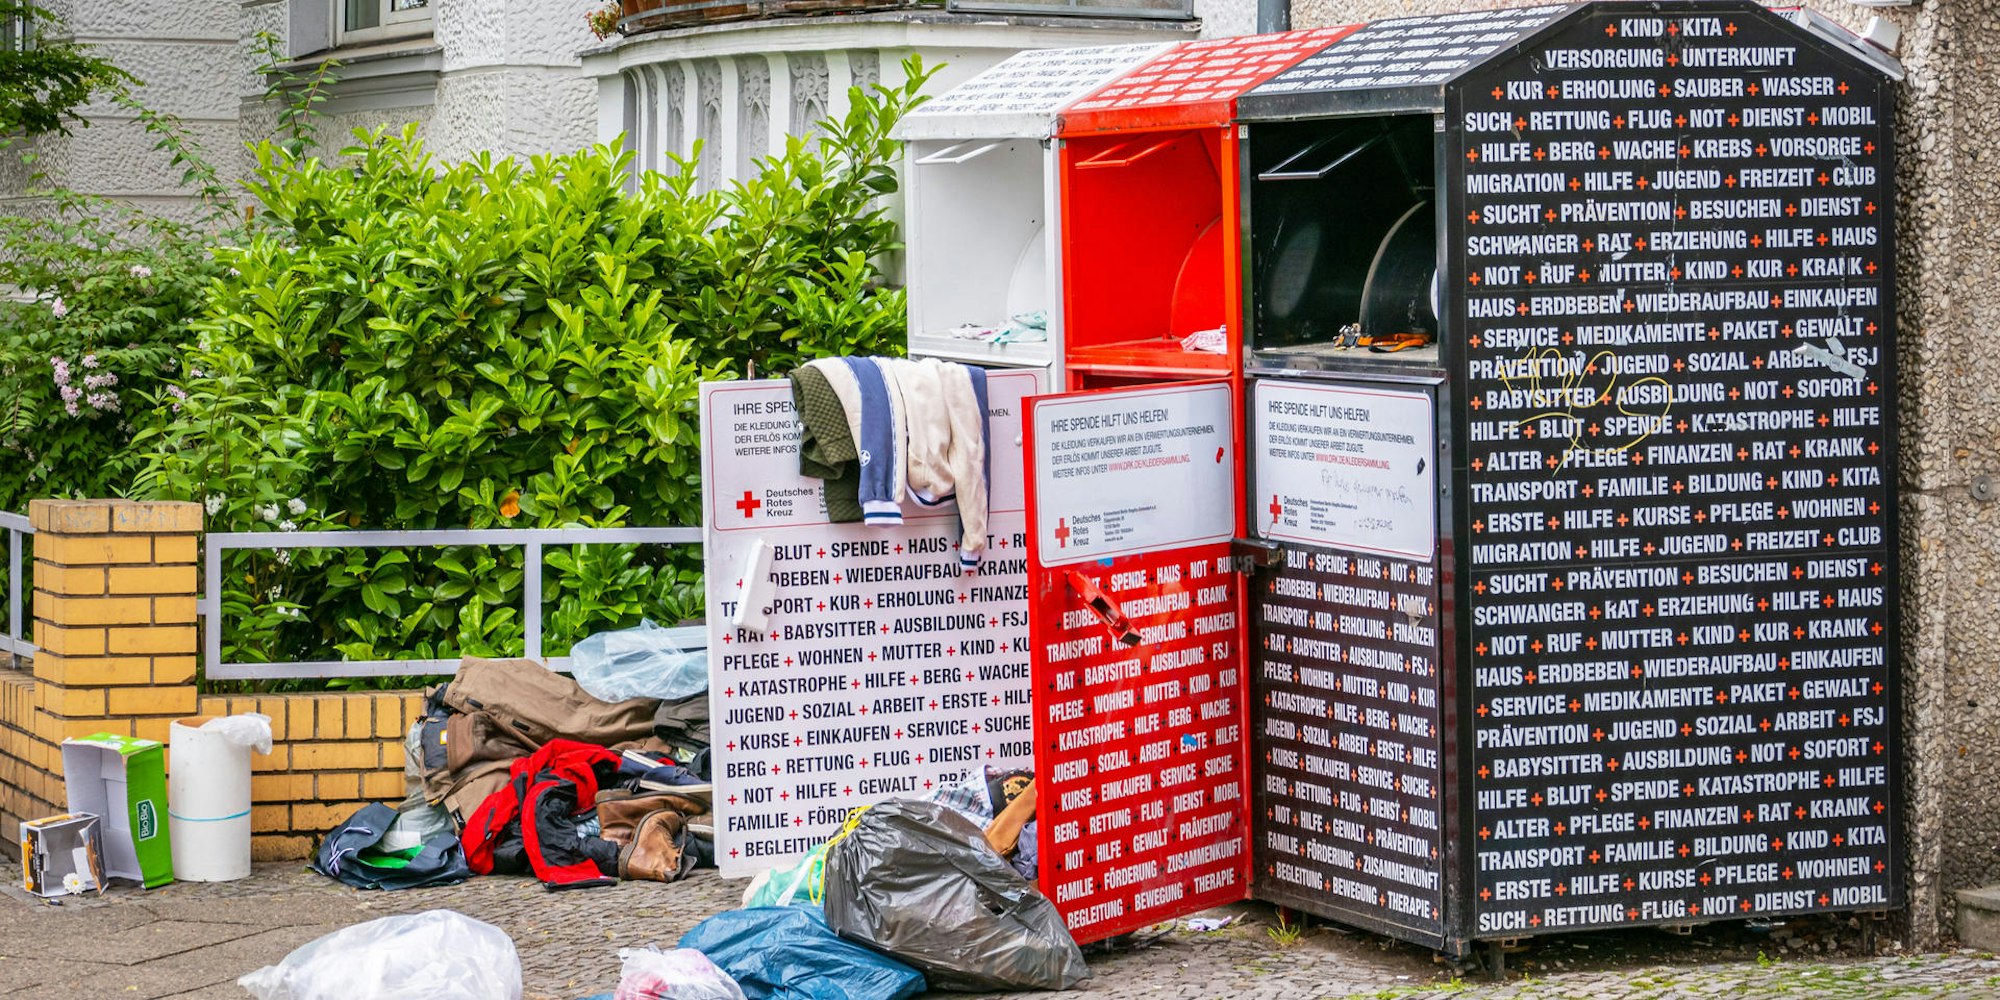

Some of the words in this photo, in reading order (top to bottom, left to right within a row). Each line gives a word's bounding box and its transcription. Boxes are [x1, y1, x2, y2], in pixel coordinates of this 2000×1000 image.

[1621, 19, 1663, 37] KIND
[1683, 18, 1722, 36] KITA
[1545, 49, 1663, 68] VERSORGUNG
[1683, 48, 1795, 67] UNTERKUNFT
[1507, 81, 1543, 100] KUR
[1563, 79, 1655, 99] ERHOLUNG
[1675, 78, 1743, 97] SAUBER
[1762, 77, 1834, 96] WASSER
[1465, 112, 1512, 132] SUCH
[1530, 111, 1610, 130] RETTUNG
[1629, 110, 1671, 128] FLUG
[1690, 109, 1725, 127] NOT
[1743, 108, 1804, 126] DIENST
[1822, 107, 1875, 125] MOBIL
[1482, 143, 1530, 162] HILFE
[1549, 142, 1595, 161] BERG
[1613, 140, 1675, 160] WACHE
[1694, 139, 1752, 158] KREBS
[1770, 137, 1861, 156] VORSORGE
[1467, 173, 1565, 193] MIGRATION
[1585, 172, 1633, 191] HILFE
[1652, 170, 1720, 190] JUGEND
[1740, 168, 1814, 187] FREIZEIT
[1833, 167, 1875, 187] CLUB
[733, 402, 762, 416] IHRE
[765, 401, 798, 414] SPEN
[1269, 401, 1283, 412] IHRE
[1285, 402, 1308, 416] SPENDE
[1310, 406, 1326, 417] HILFT
[1329, 408, 1342, 420] UNS
[734, 423, 748, 432] DIE
[749, 420, 791, 431] KLEIDUNG
[1051, 419, 1068, 432] IHRE
[1071, 416, 1099, 430] SPENDE
[1102, 413, 1120, 427] HILFT
[1123, 412, 1137, 425] UNS
[734, 435, 752, 444] DER
[754, 432, 781, 444] ERLÖS
[782, 431, 801, 441] KOM
[734, 446, 771, 457] WEITERE
[773, 444, 798, 455] INFOS
[766, 487, 814, 498] Deutsches
[1471, 480, 1577, 502] TRANSPORT
[1599, 476, 1668, 497] FAMILIE
[1689, 472, 1762, 493] BILDUNG
[1782, 470, 1823, 489] KIND
[1843, 467, 1880, 486] KITA
[766, 499, 793, 508] Rotes
[766, 509, 793, 518] Kreuz
[1284, 496, 1308, 507] Deutsches
[1284, 507, 1297, 517] Rotes
[1072, 514, 1100, 525] Deutsches
[1073, 527, 1088, 535] Rotes
[1284, 518, 1297, 527] Kreuz
[1073, 537, 1089, 546] Kreuz
[846, 563, 961, 583] WIEDERAUFBAU
[978, 559, 1027, 576] KRANK
[1288, 550, 1307, 569] BLUT
[1316, 553, 1347, 574] SPENDE
[1357, 558, 1381, 579] HAUS
[1390, 562, 1408, 582] NOT
[1417, 566, 1433, 586] RUF
[724, 653, 779, 670] PFLEGE
[799, 648, 862, 665] WOHNEN
[883, 643, 941, 660] MUTTER
[961, 640, 994, 655] KIND
[1057, 671, 1074, 691] RAT
[1085, 658, 1141, 686] BABYSITTER
[1151, 646, 1204, 673] AUSBILDUNG
[1213, 642, 1228, 660] FSJ
[1271, 634, 1285, 652] RAT
[1293, 637, 1340, 662] BABYSITTER
[1349, 646, 1403, 672] AUSBILDUNG
[1412, 656, 1427, 676] FSJ
[740, 676, 847, 696] KATASTROPHE
[866, 672, 905, 688] HILFE
[924, 668, 960, 684] BERG
[979, 663, 1028, 680] WACHE
[725, 707, 784, 724] JUGEND
[803, 702, 855, 719] SOZIAL
[873, 697, 925, 714] ARBEIT
[943, 692, 987, 709] ERSTE
[1005, 689, 1032, 705] HILF
[1050, 700, 1084, 723] PFLEGE
[1094, 689, 1134, 714] WOHNEN
[1144, 680, 1180, 704] MUTTER
[1190, 674, 1210, 694] KIND
[1220, 669, 1236, 687] KUR
[741, 733, 789, 750] KURSE
[808, 726, 889, 745] EINKAUFEN
[908, 720, 967, 738] SERVICE
[985, 715, 1030, 732] SUCHE
[1477, 724, 1588, 748] PRÄVENTION
[1608, 720, 1676, 741] JUGEND
[1696, 715, 1756, 736] SOZIAL
[1775, 710, 1835, 731] ARBEIT
[1854, 707, 1883, 726] FSJ
[727, 761, 765, 778] BERG
[787, 755, 853, 773] RETTUNG
[874, 751, 909, 767] FLUG
[930, 745, 980, 762] DIENST
[1494, 754, 1602, 778] BABYSITTER
[1623, 746, 1731, 770] AUSBILDUNG
[1752, 743, 1785, 762] NOT
[1804, 738, 1869, 759] SOFORT
[1061, 788, 1092, 811] KURSE
[1101, 774, 1151, 801] EINKAUFEN
[1160, 763, 1196, 787] SERVICE
[1205, 755, 1232, 776] SUCHE
[1273, 748, 1298, 769] KURSE
[1306, 755, 1349, 781] EINKAUFEN
[1358, 765, 1393, 790] SERVICE
[1402, 774, 1429, 798] SUCHE
[1055, 821, 1079, 843] BERG
[1090, 808, 1130, 834] RETTUNG
[1141, 800, 1163, 821] FLUG
[1174, 790, 1204, 813] DIENST
[1214, 782, 1240, 802] MOBIL
[1267, 775, 1286, 795] BERG
[1296, 781, 1331, 805] RETTUNG
[1340, 791, 1361, 812] FLUG
[1370, 797, 1400, 821] DIENST
[1410, 806, 1437, 830] MOBIL
[1057, 877, 1093, 903] FAMILIE
[1104, 860, 1157, 890] FÖRDERUNG
[1167, 838, 1241, 873] ZUSAMMENKUNFT
[1277, 862, 1322, 889] BEGLEITUNG
[1333, 877, 1377, 905] BEWEGUNG
[1387, 891, 1430, 919] THERAPIE
